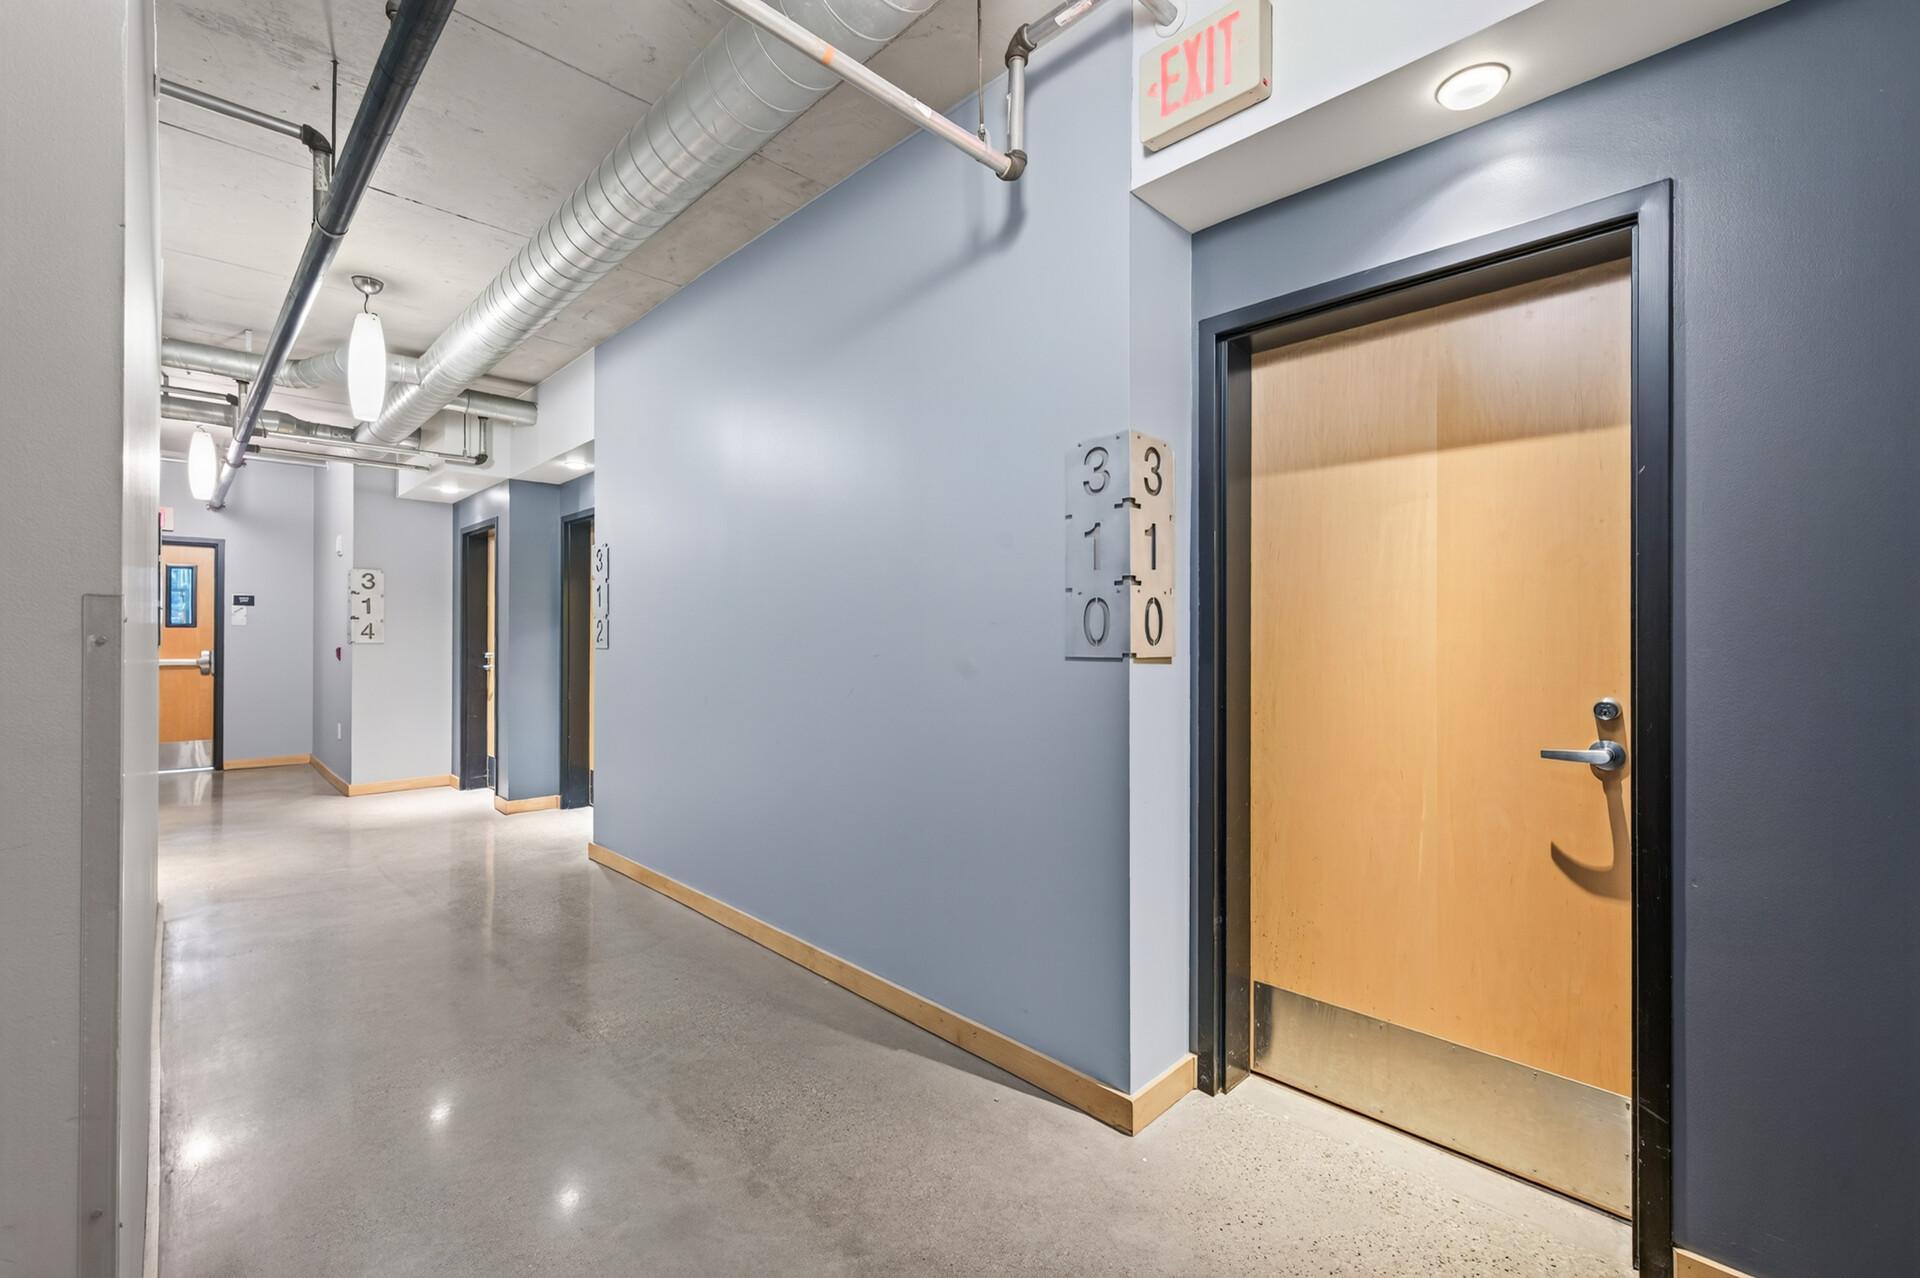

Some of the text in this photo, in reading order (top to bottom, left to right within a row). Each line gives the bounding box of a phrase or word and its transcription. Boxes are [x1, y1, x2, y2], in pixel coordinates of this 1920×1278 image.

[1160, 10, 1240, 118] EXIT
[595, 548, 603, 644] 312
[1083, 446, 1111, 647] 310
[1143, 446, 1163, 647] 310
[360, 572, 376, 640] 314
